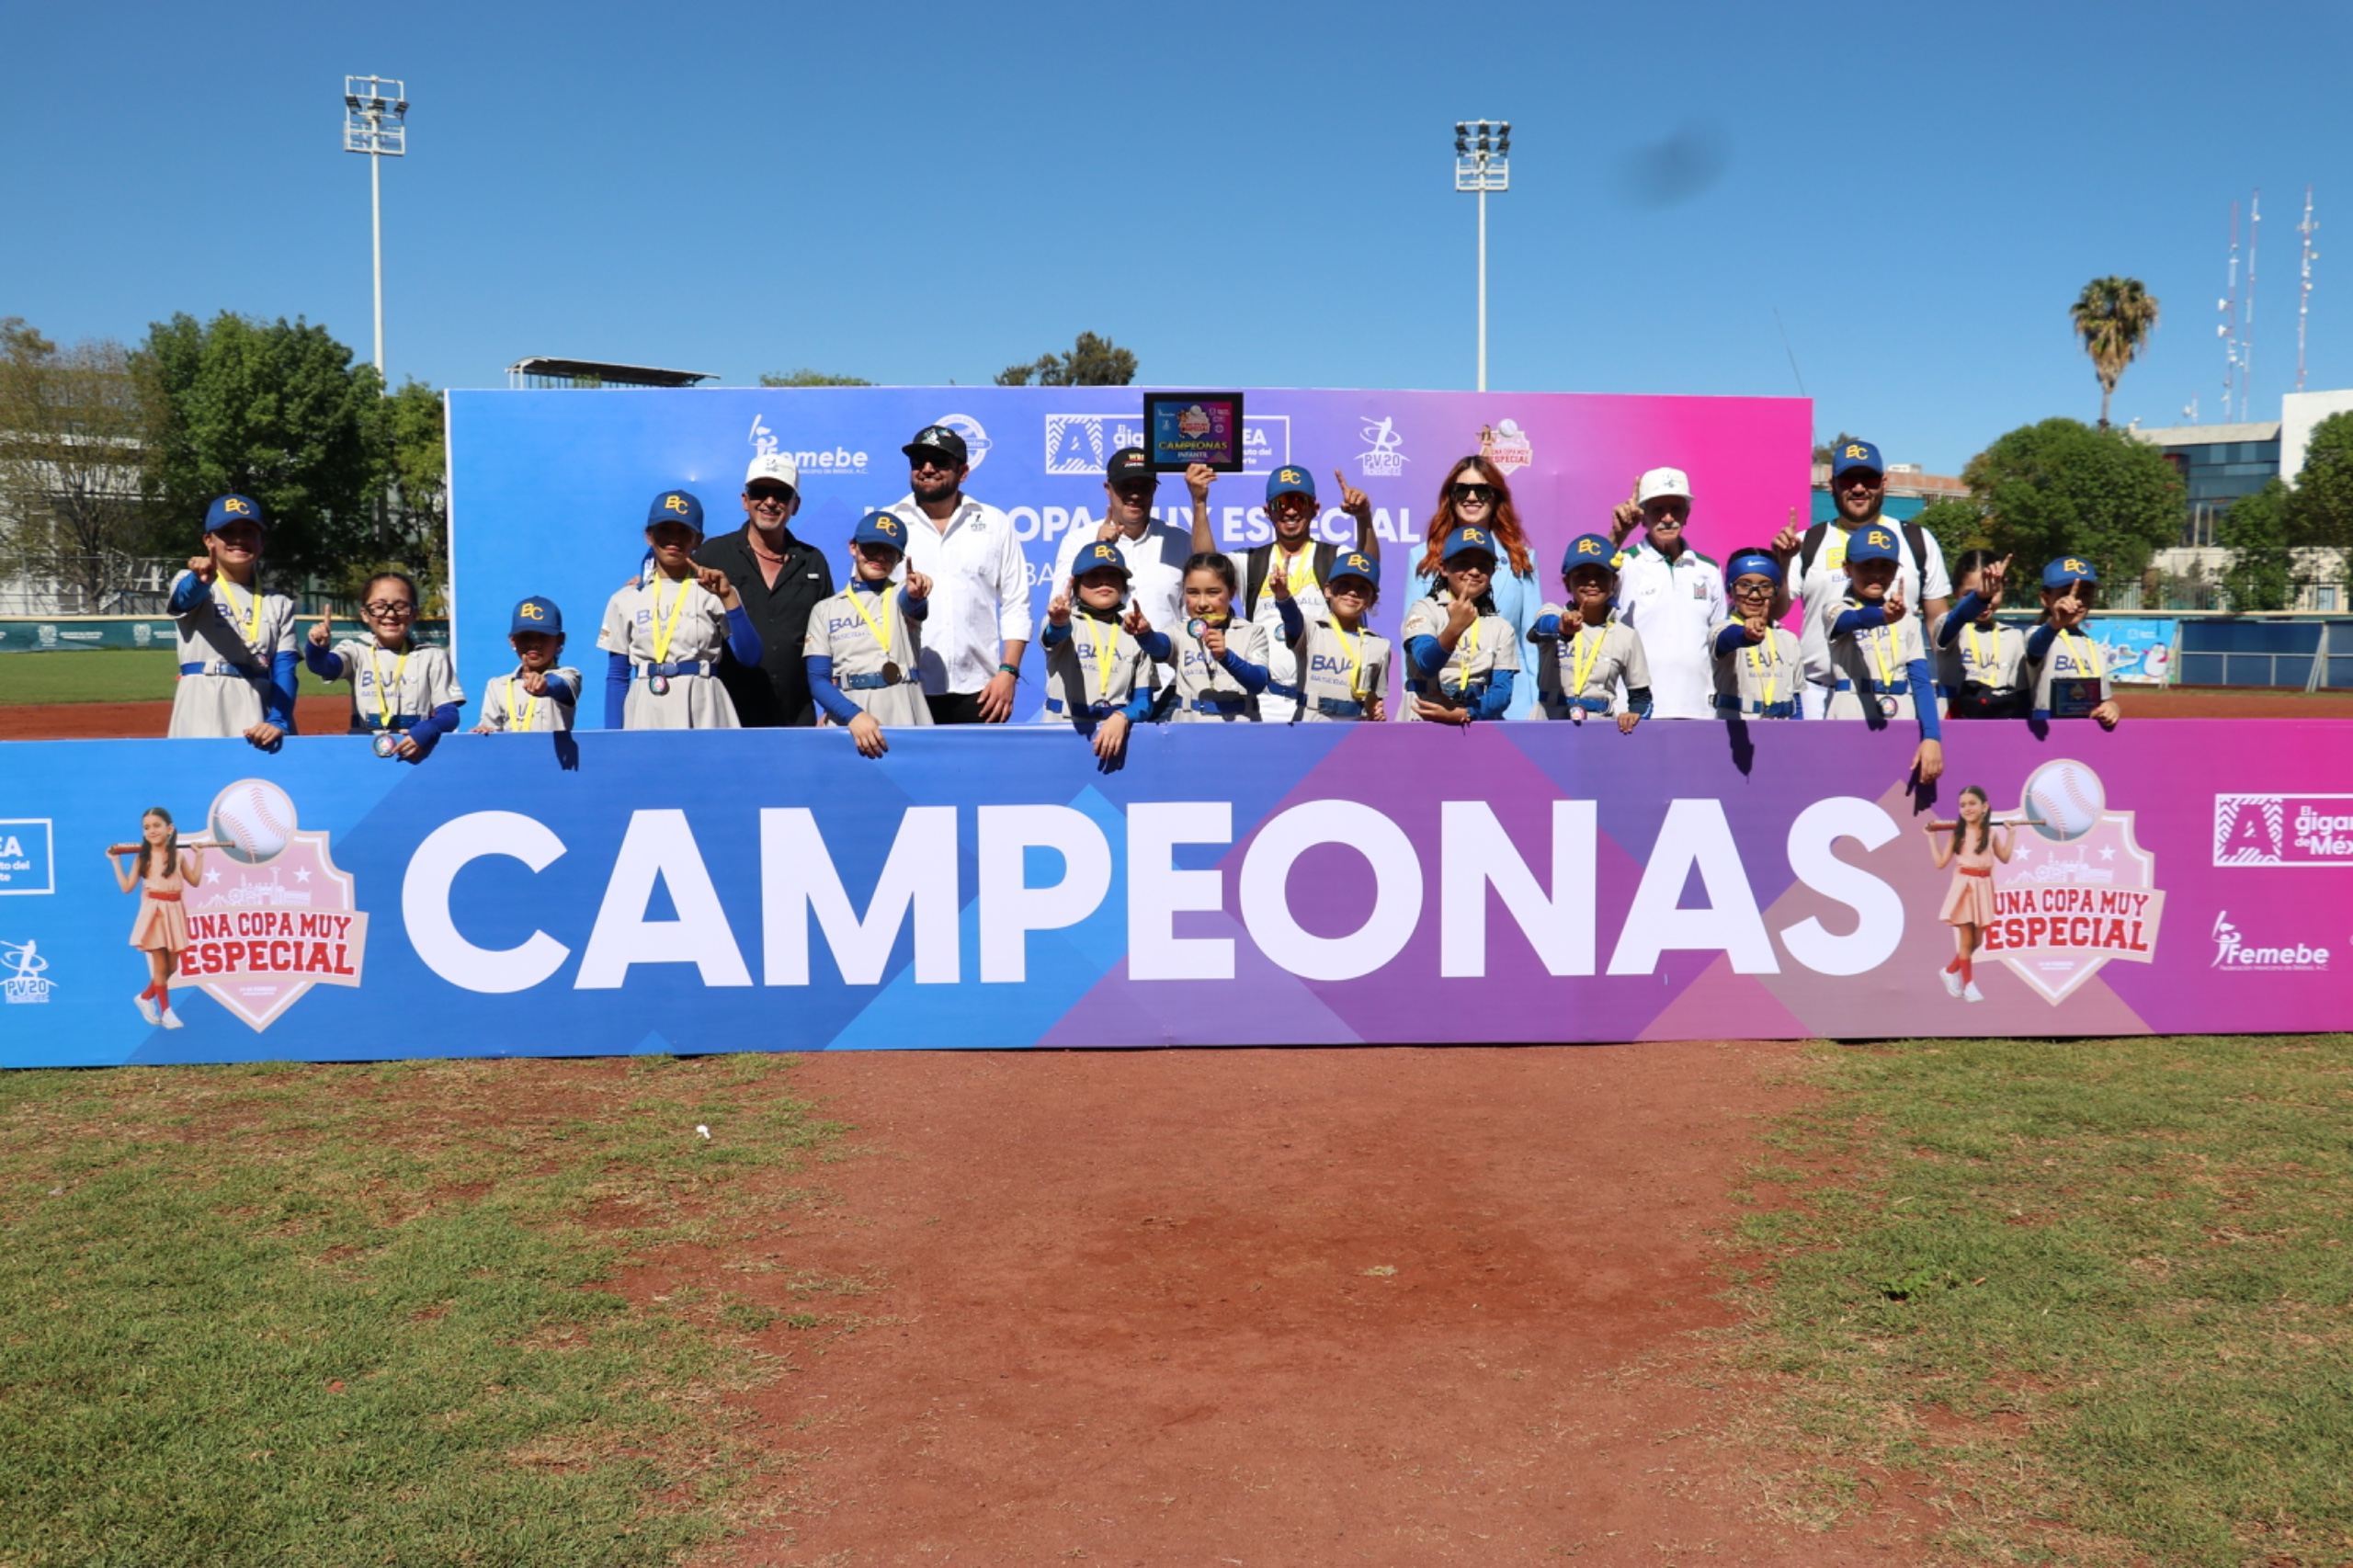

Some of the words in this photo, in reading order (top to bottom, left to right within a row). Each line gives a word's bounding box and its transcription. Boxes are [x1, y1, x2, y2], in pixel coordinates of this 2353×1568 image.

[1243, 428, 1267, 446] EA
[1159, 442, 1228, 451] CAMPEONAS
[1845, 444, 1870, 460] BC
[1279, 469, 1302, 484] BC
[225, 498, 251, 515] BC
[664, 495, 688, 515] BC
[875, 517, 898, 537] BC
[1462, 528, 1486, 544] BC
[1578, 539, 1602, 556] BC
[1868, 530, 1892, 550] BC
[1095, 545, 1118, 562] BC
[1347, 554, 1370, 573] BC
[2063, 558, 2088, 574] BC
[520, 603, 544, 620] BC
[402, 796, 1904, 994] CAMPEONAS
[1994, 889, 2037, 915] UNA
[2042, 889, 2093, 913] COPA
[2099, 890, 2149, 917] MUY
[187, 913, 233, 939] UNA
[238, 912, 294, 937] COPA
[300, 913, 351, 939] MUY
[1984, 916, 2149, 951] ESPECIAL
[179, 940, 355, 977] ESPECIAL
[2227, 942, 2330, 964] Femebe
